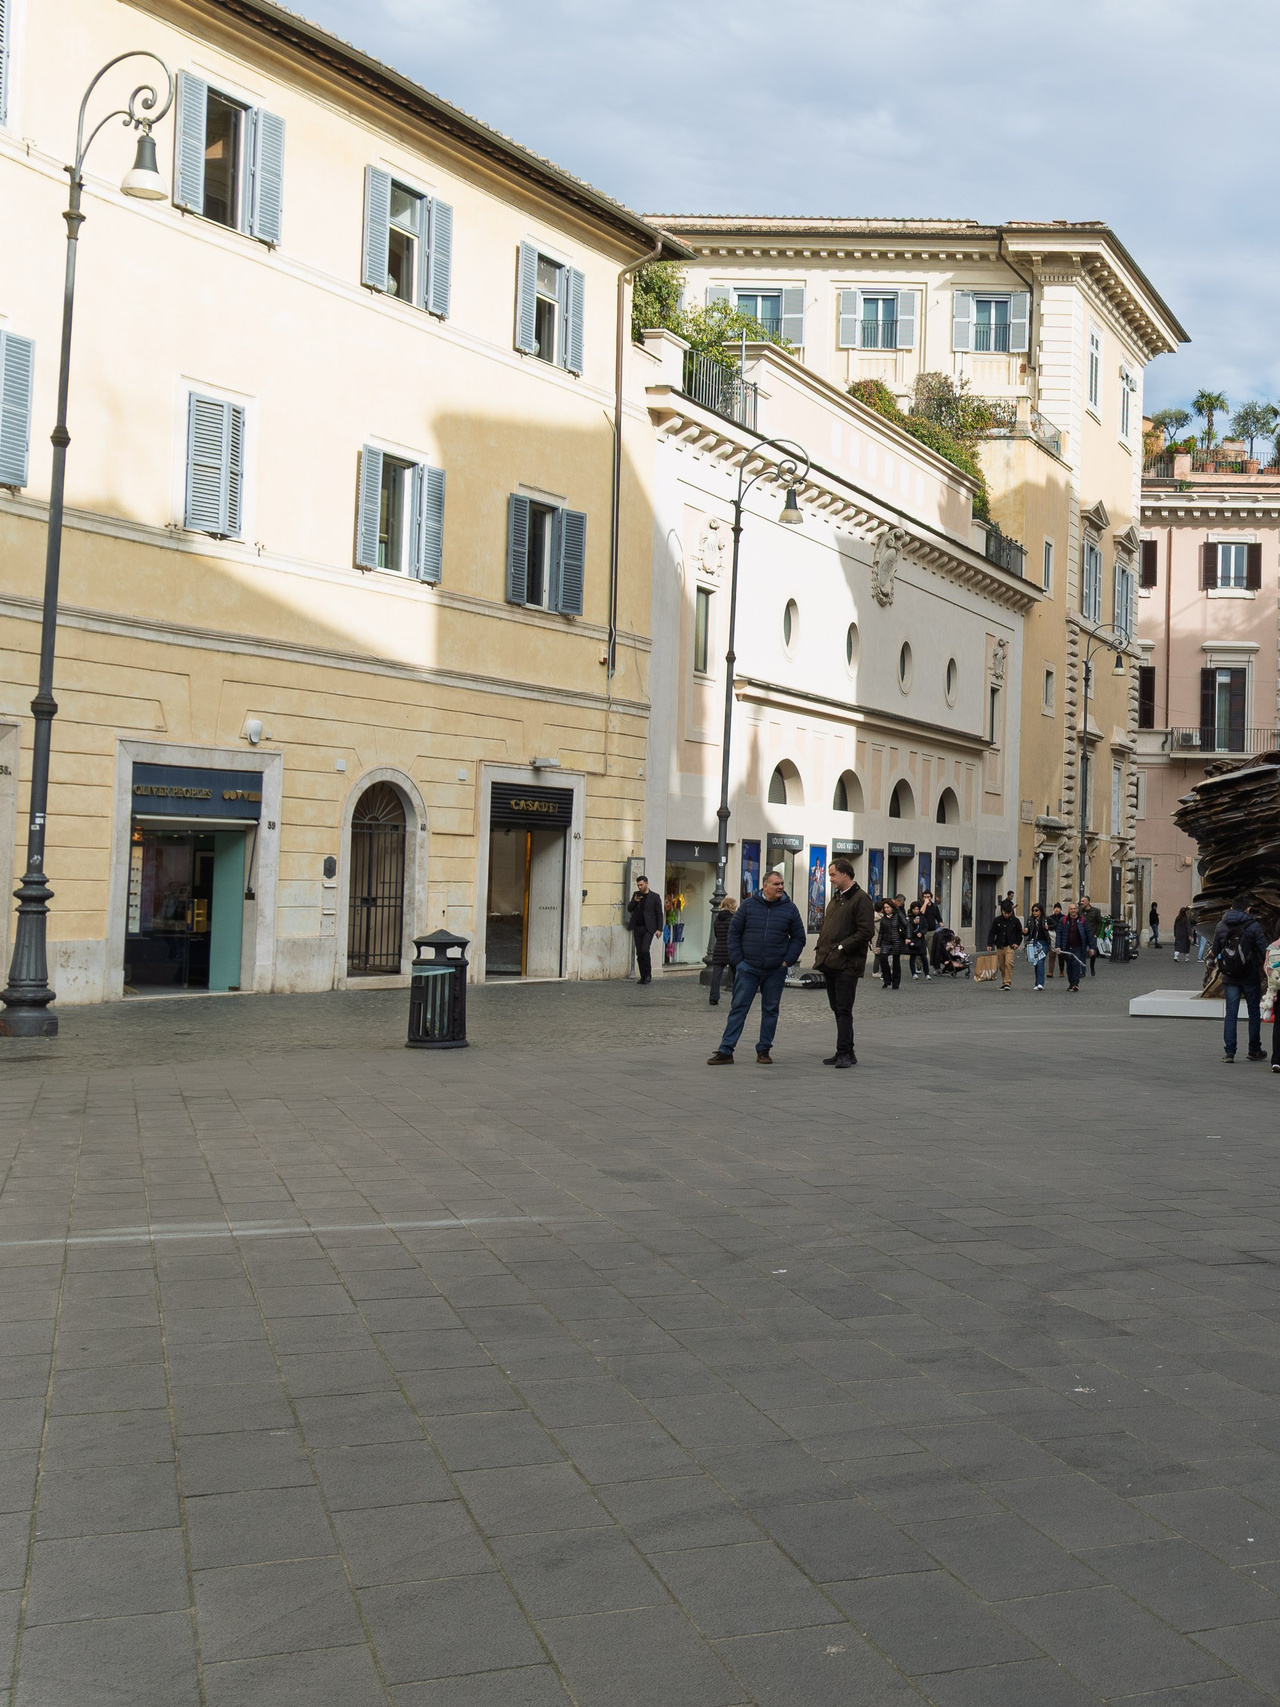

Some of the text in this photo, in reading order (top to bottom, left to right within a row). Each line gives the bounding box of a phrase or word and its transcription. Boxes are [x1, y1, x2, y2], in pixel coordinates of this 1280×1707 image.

[132, 784, 169, 797] OLIVER
[170, 786, 212, 799] PEOPLES
[510, 799, 558, 812] CASADEI
[267, 820, 276, 830] 39
[771, 837, 800, 846] LOUIS VUITTON
[891, 845, 900, 853] LOUIS
